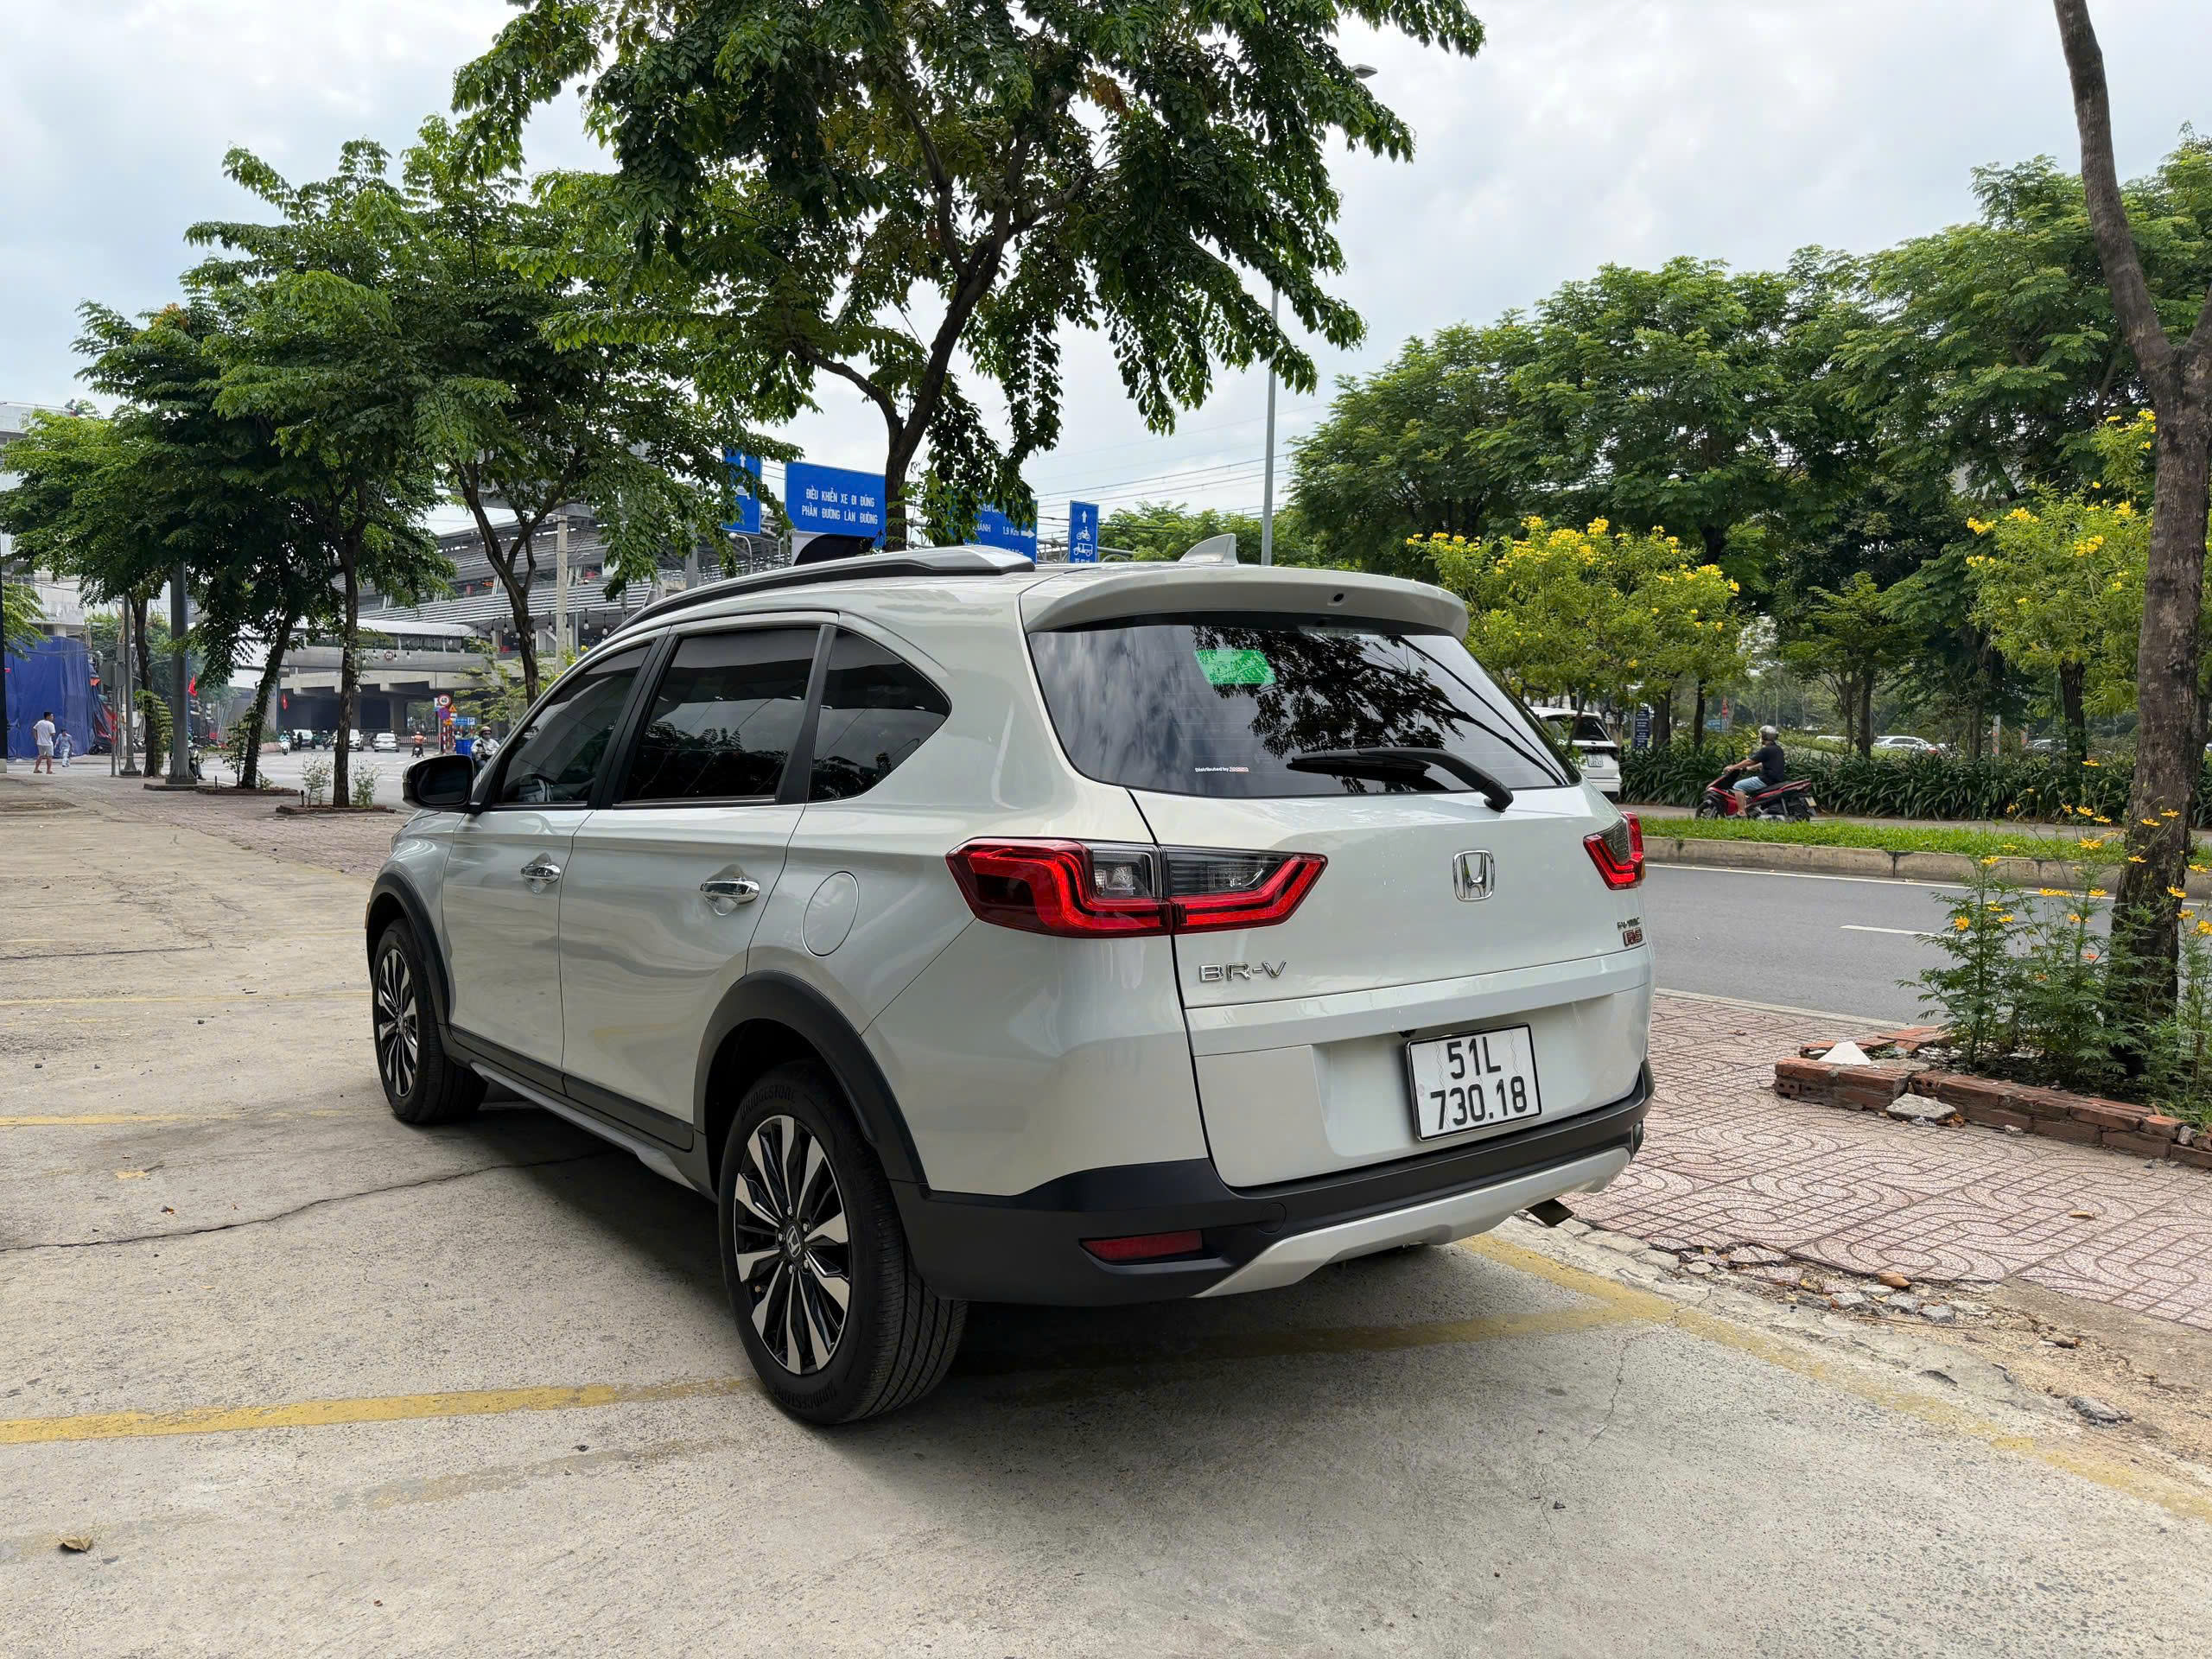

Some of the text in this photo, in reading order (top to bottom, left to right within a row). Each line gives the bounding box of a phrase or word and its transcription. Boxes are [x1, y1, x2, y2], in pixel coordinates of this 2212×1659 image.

[840, 493, 849, 505] XE
[860, 494, 875, 508] ĐÚNG
[843, 509, 856, 523] LÀN
[1198, 960, 1287, 983] BR-V
[1446, 1037, 1502, 1079] 51L
[1430, 1076, 1528, 1130] 730.18
